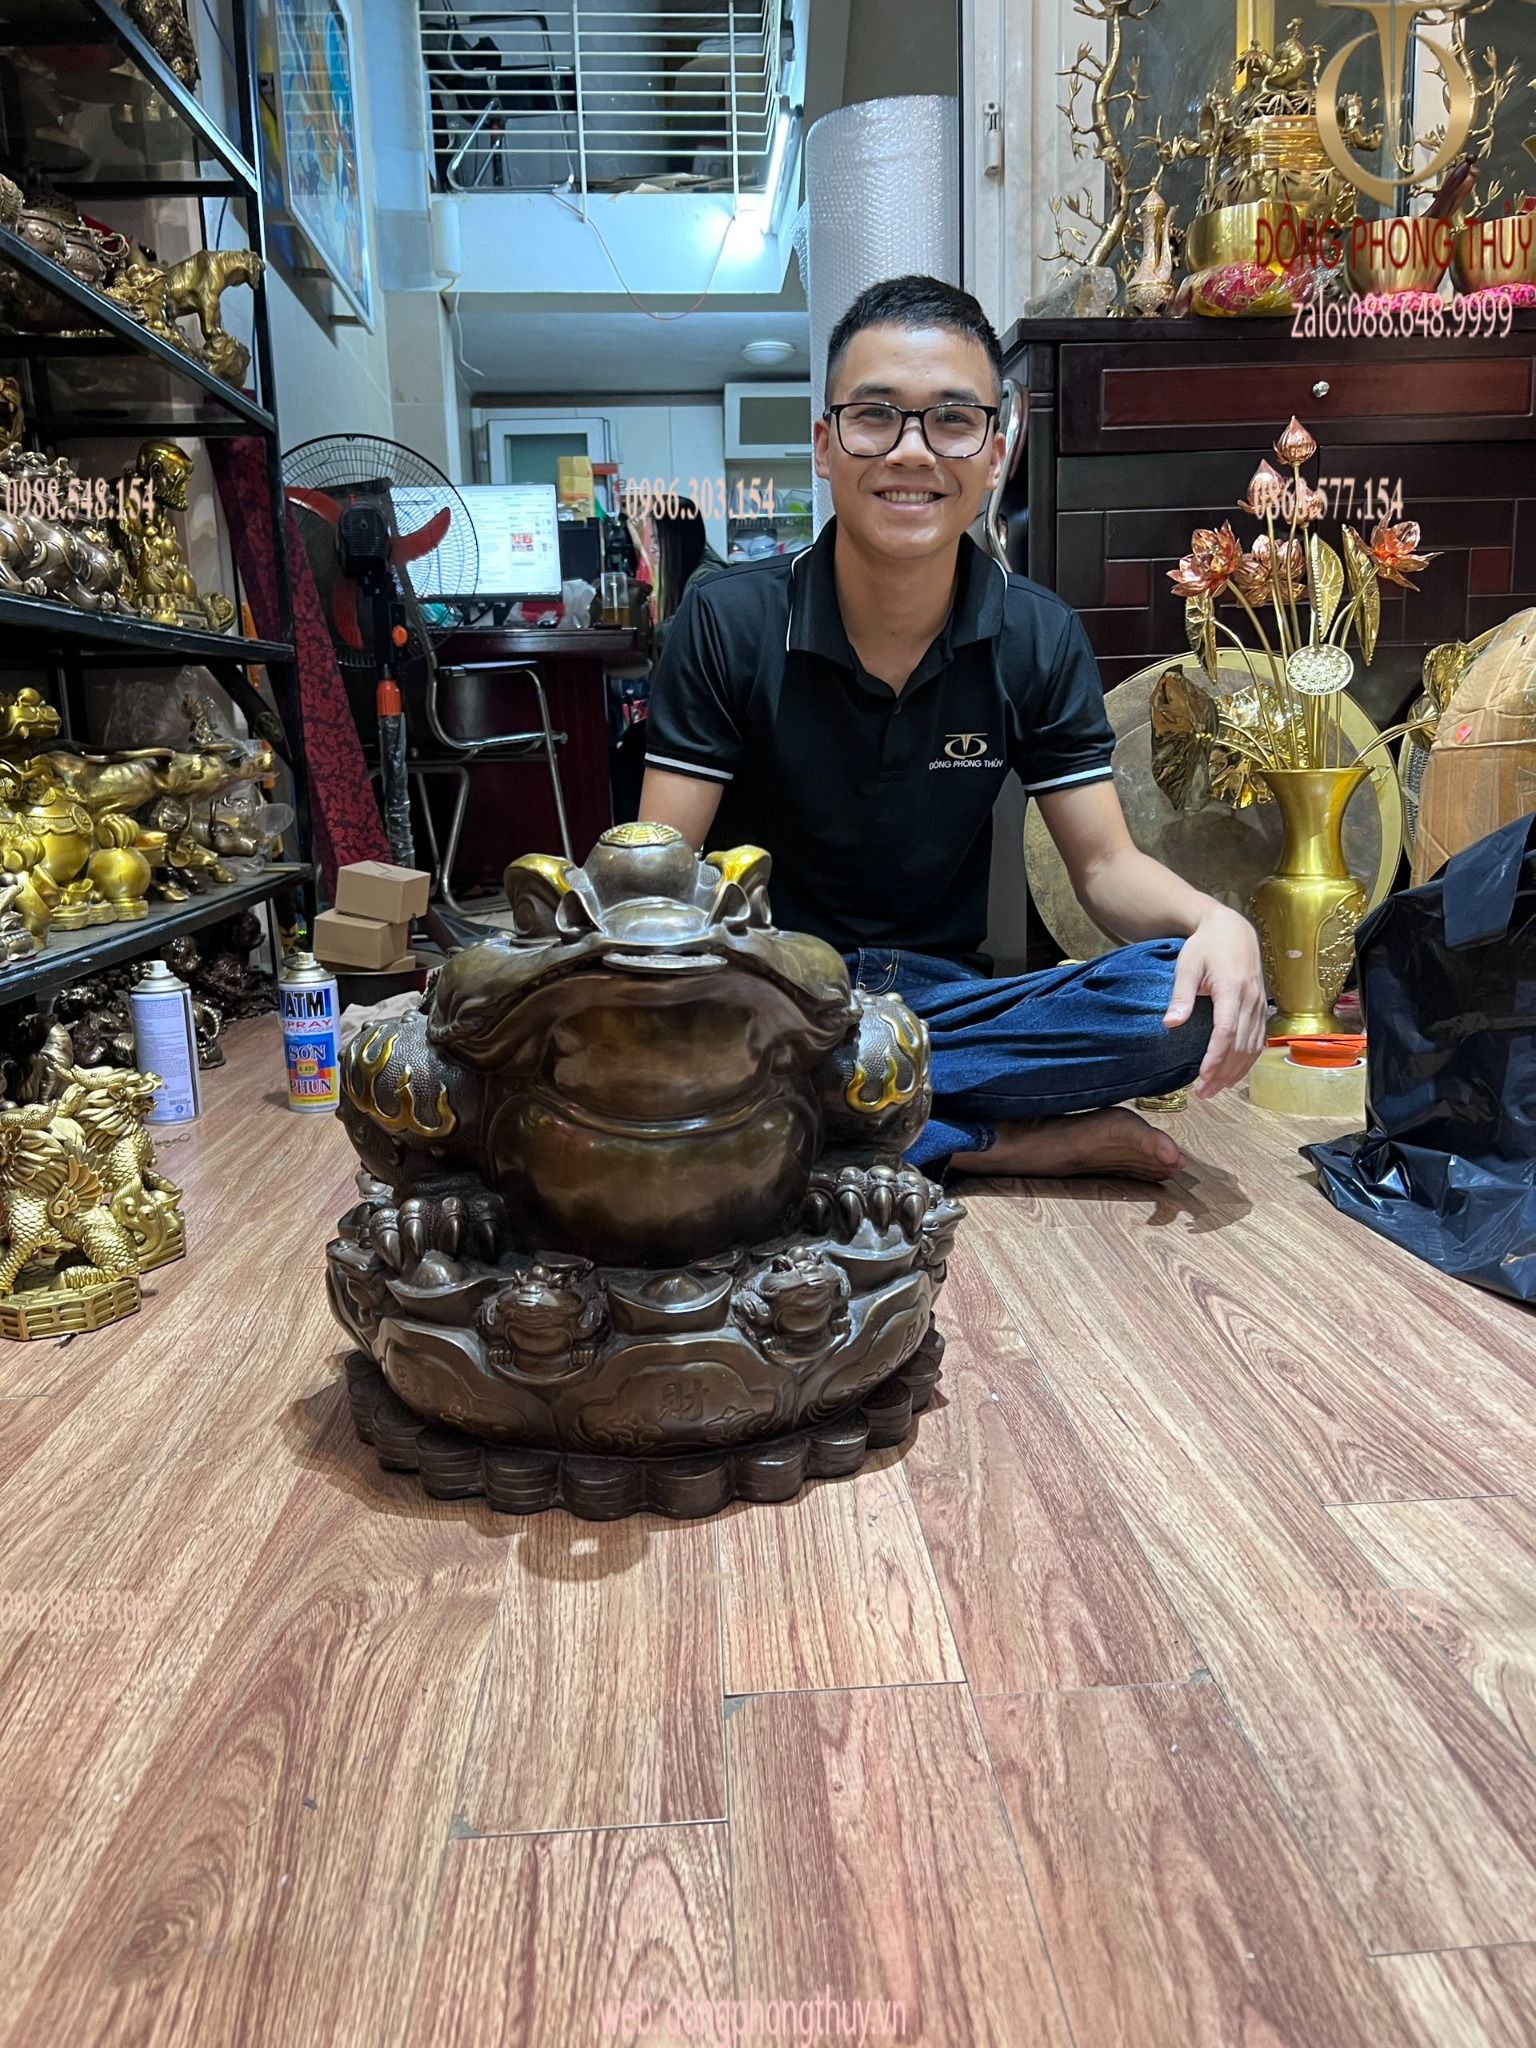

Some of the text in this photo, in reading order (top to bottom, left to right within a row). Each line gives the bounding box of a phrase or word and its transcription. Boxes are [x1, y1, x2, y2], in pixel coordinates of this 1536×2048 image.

[952, 759, 982, 768] PHONG
[285, 991, 325, 1018] ATM
[289, 1078, 333, 1094] PHUN
